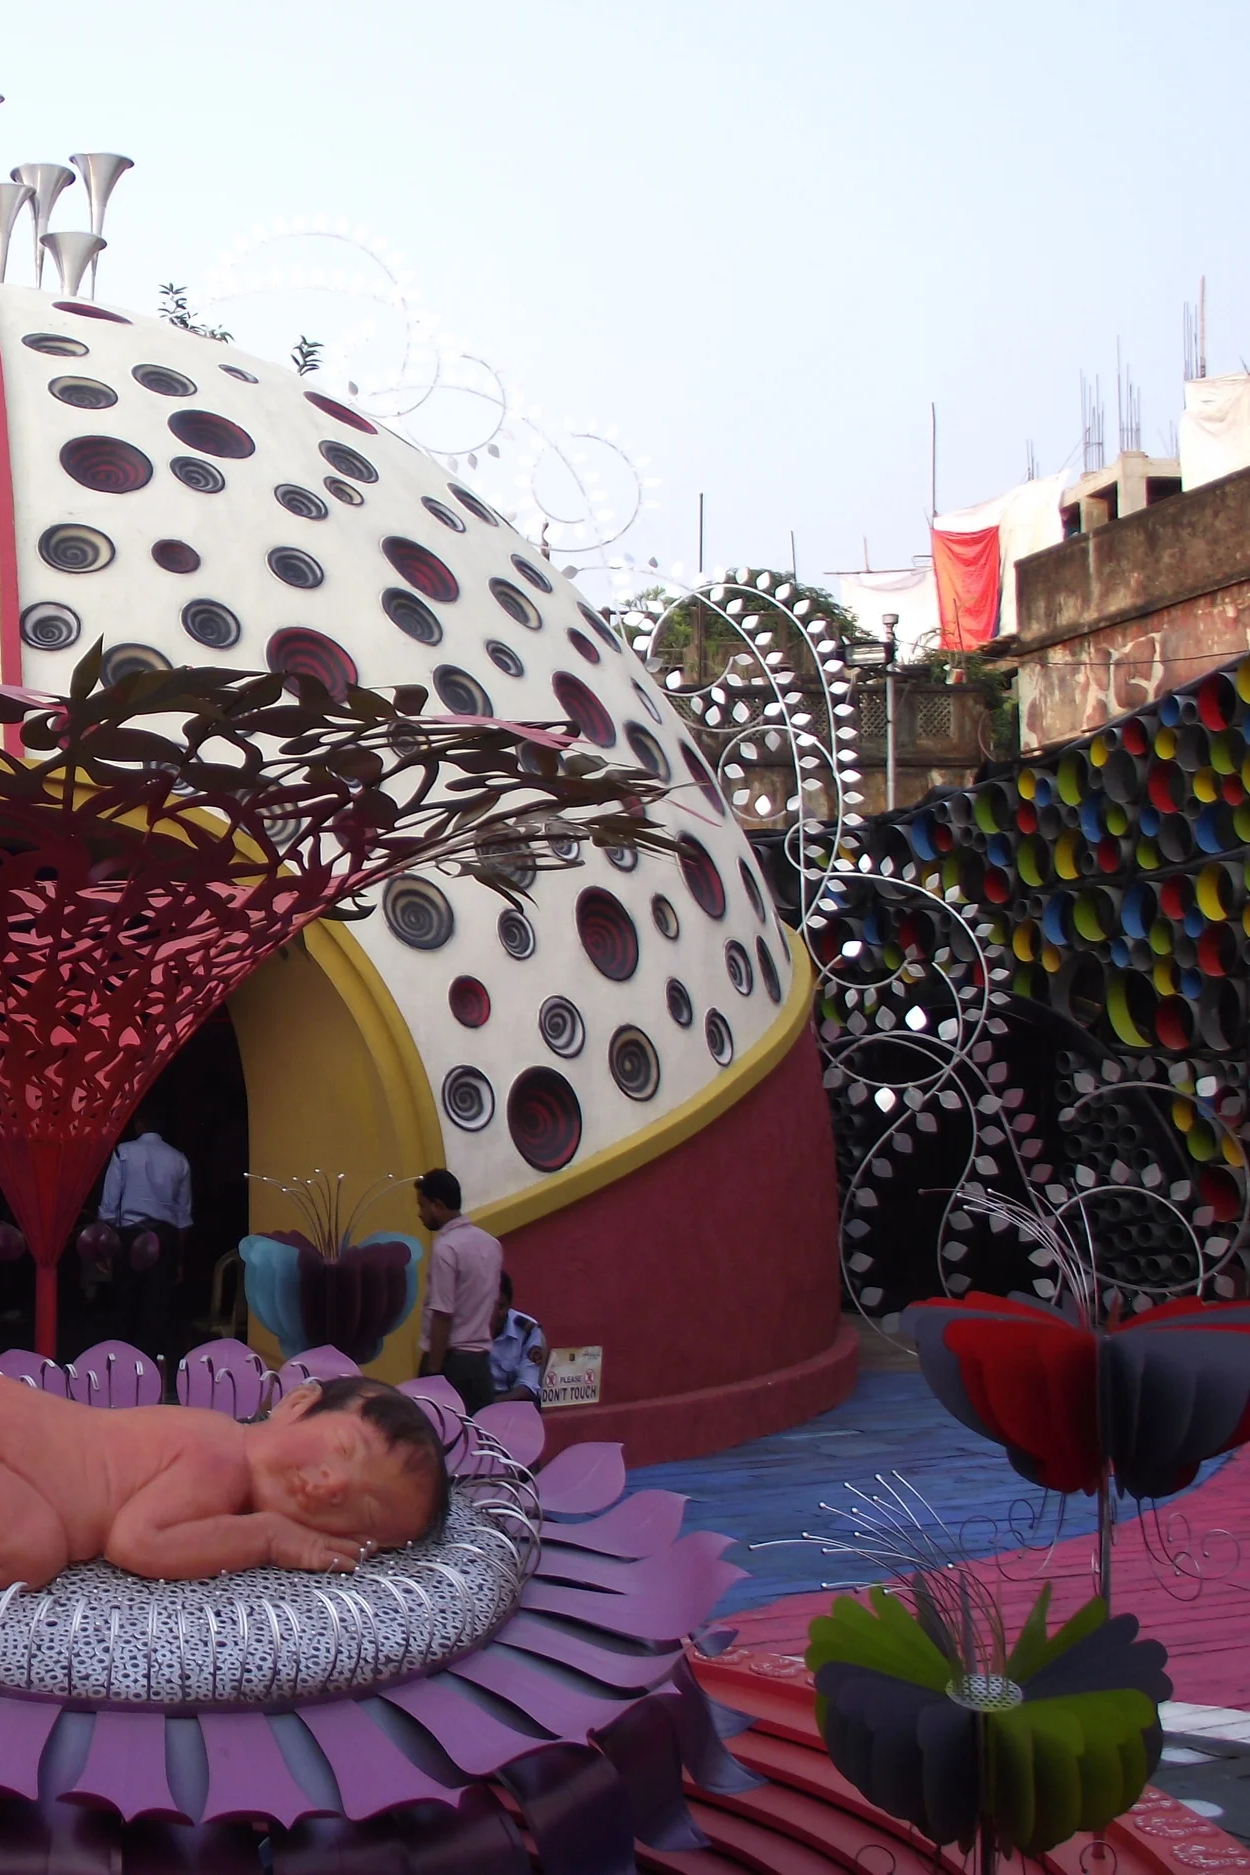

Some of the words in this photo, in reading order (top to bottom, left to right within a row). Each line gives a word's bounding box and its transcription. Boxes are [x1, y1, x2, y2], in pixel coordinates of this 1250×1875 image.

[559, 1375, 582, 1384] PLEASE
[542, 1387, 567, 1402] DON'T
[570, 1385, 597, 1400] TOUCH
